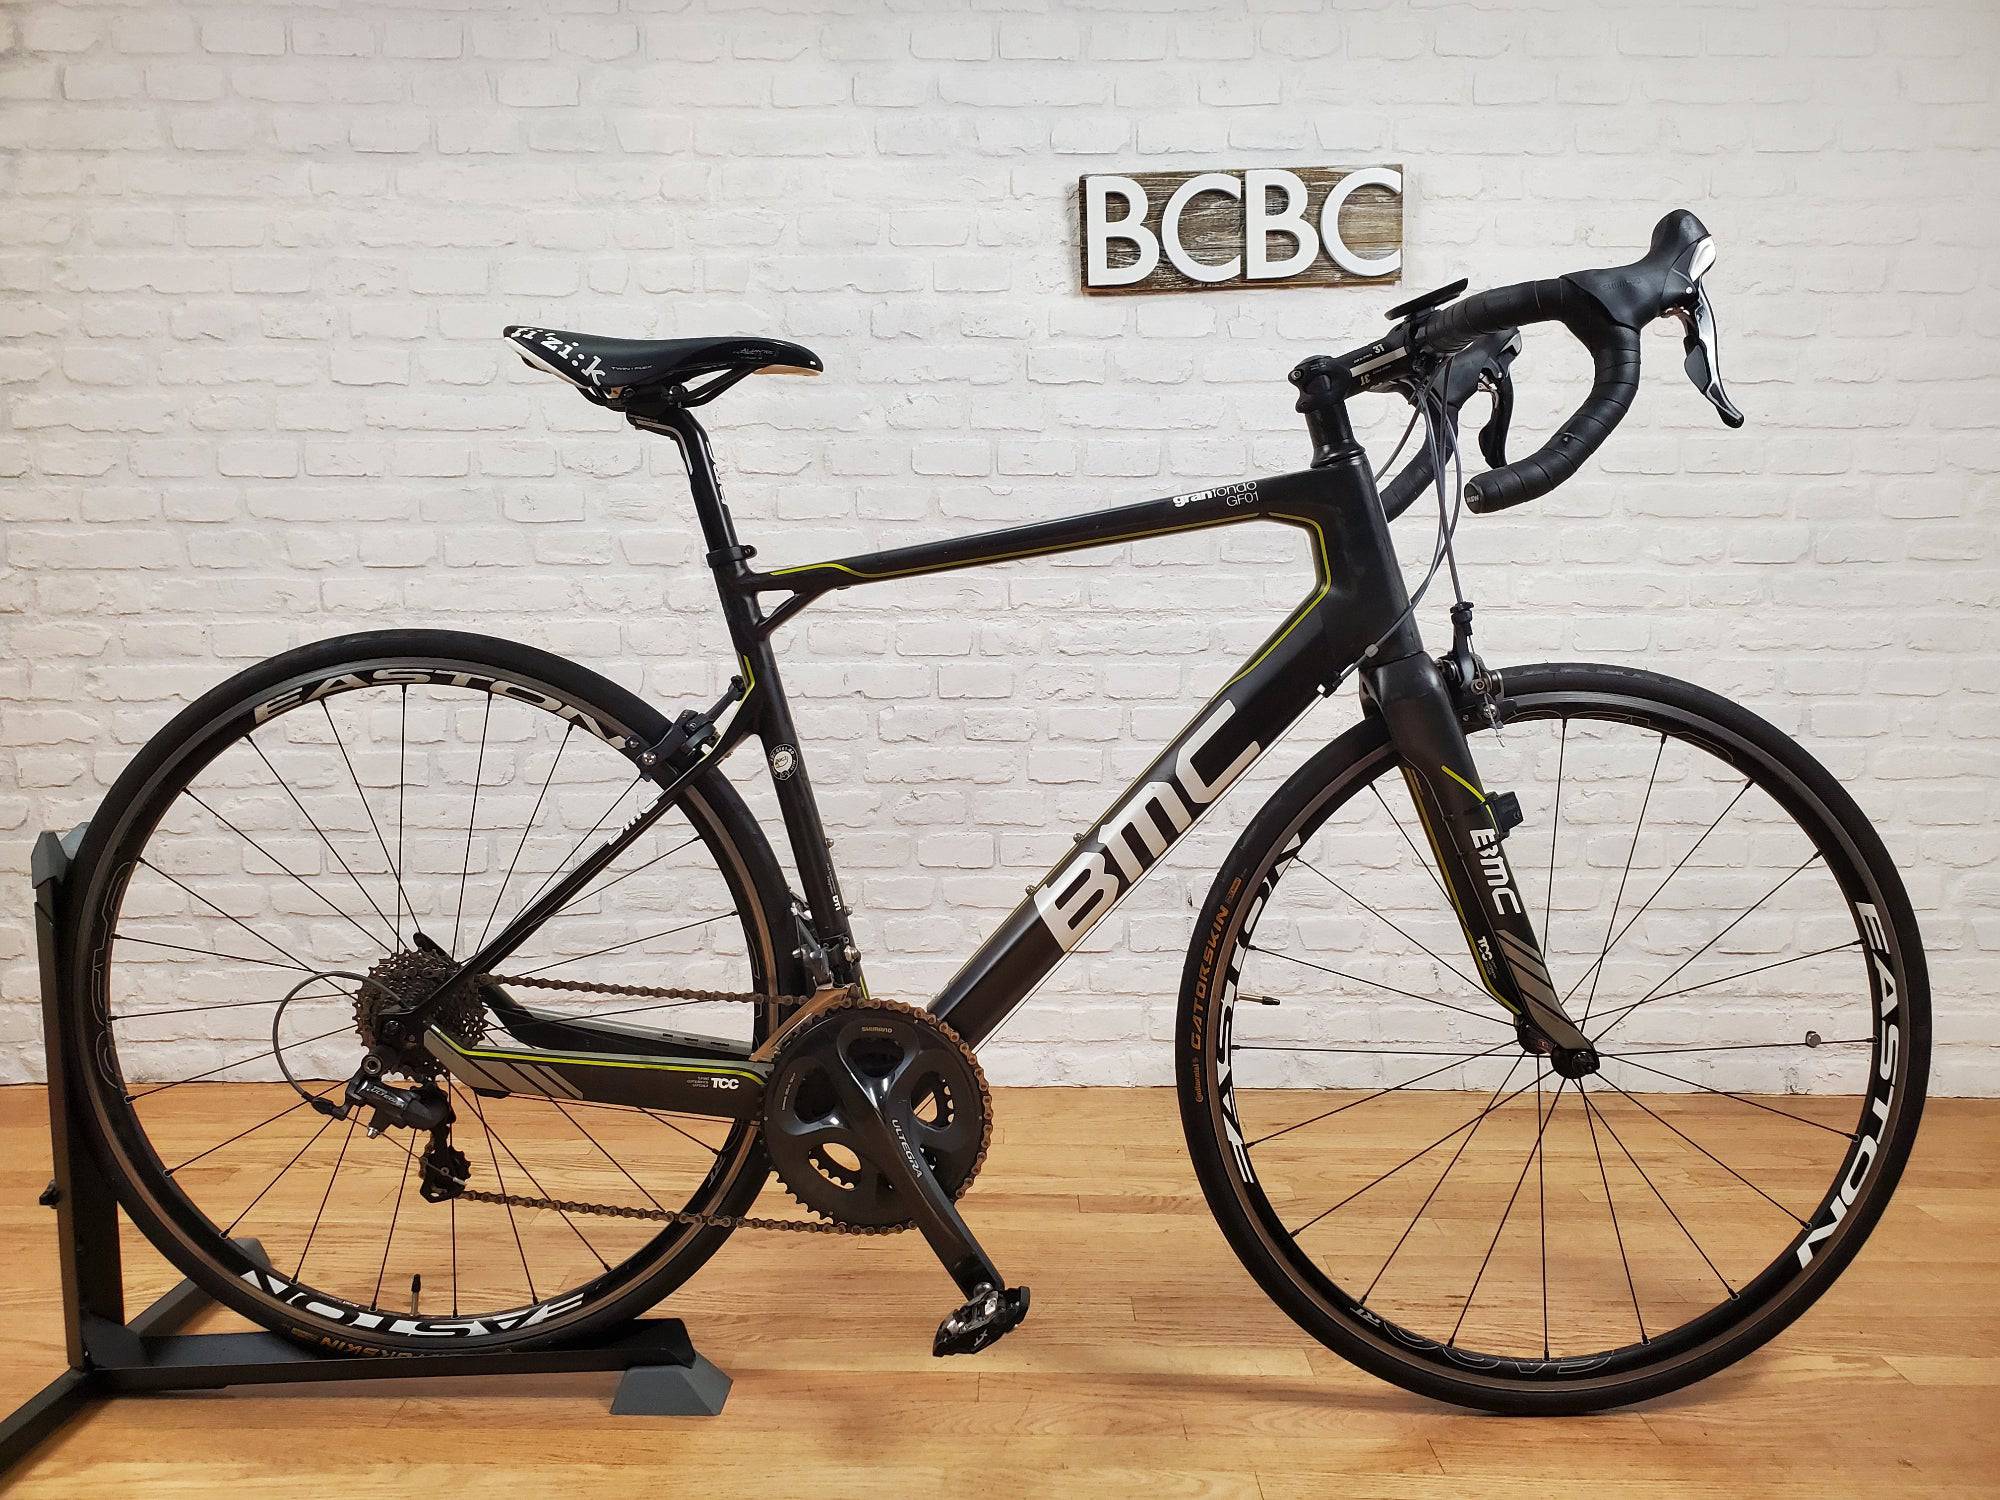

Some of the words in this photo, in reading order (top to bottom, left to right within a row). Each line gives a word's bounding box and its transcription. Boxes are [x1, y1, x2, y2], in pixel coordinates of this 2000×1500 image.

[1085, 167, 1402, 287] BCBC
[1226, 491, 1259, 507] GF01
[255, 668, 628, 751] EASTON
[1034, 699, 1261, 953] BMC
[1190, 905, 1230, 1051] GATORSKIN
[1215, 832, 1302, 1184] EASTON
[711, 1077, 740, 1090] TCC
[1796, 901, 1900, 1270] EASTON
[891, 1119, 924, 1179] ULTEGRA
[240, 1269, 585, 1337] EASTON
